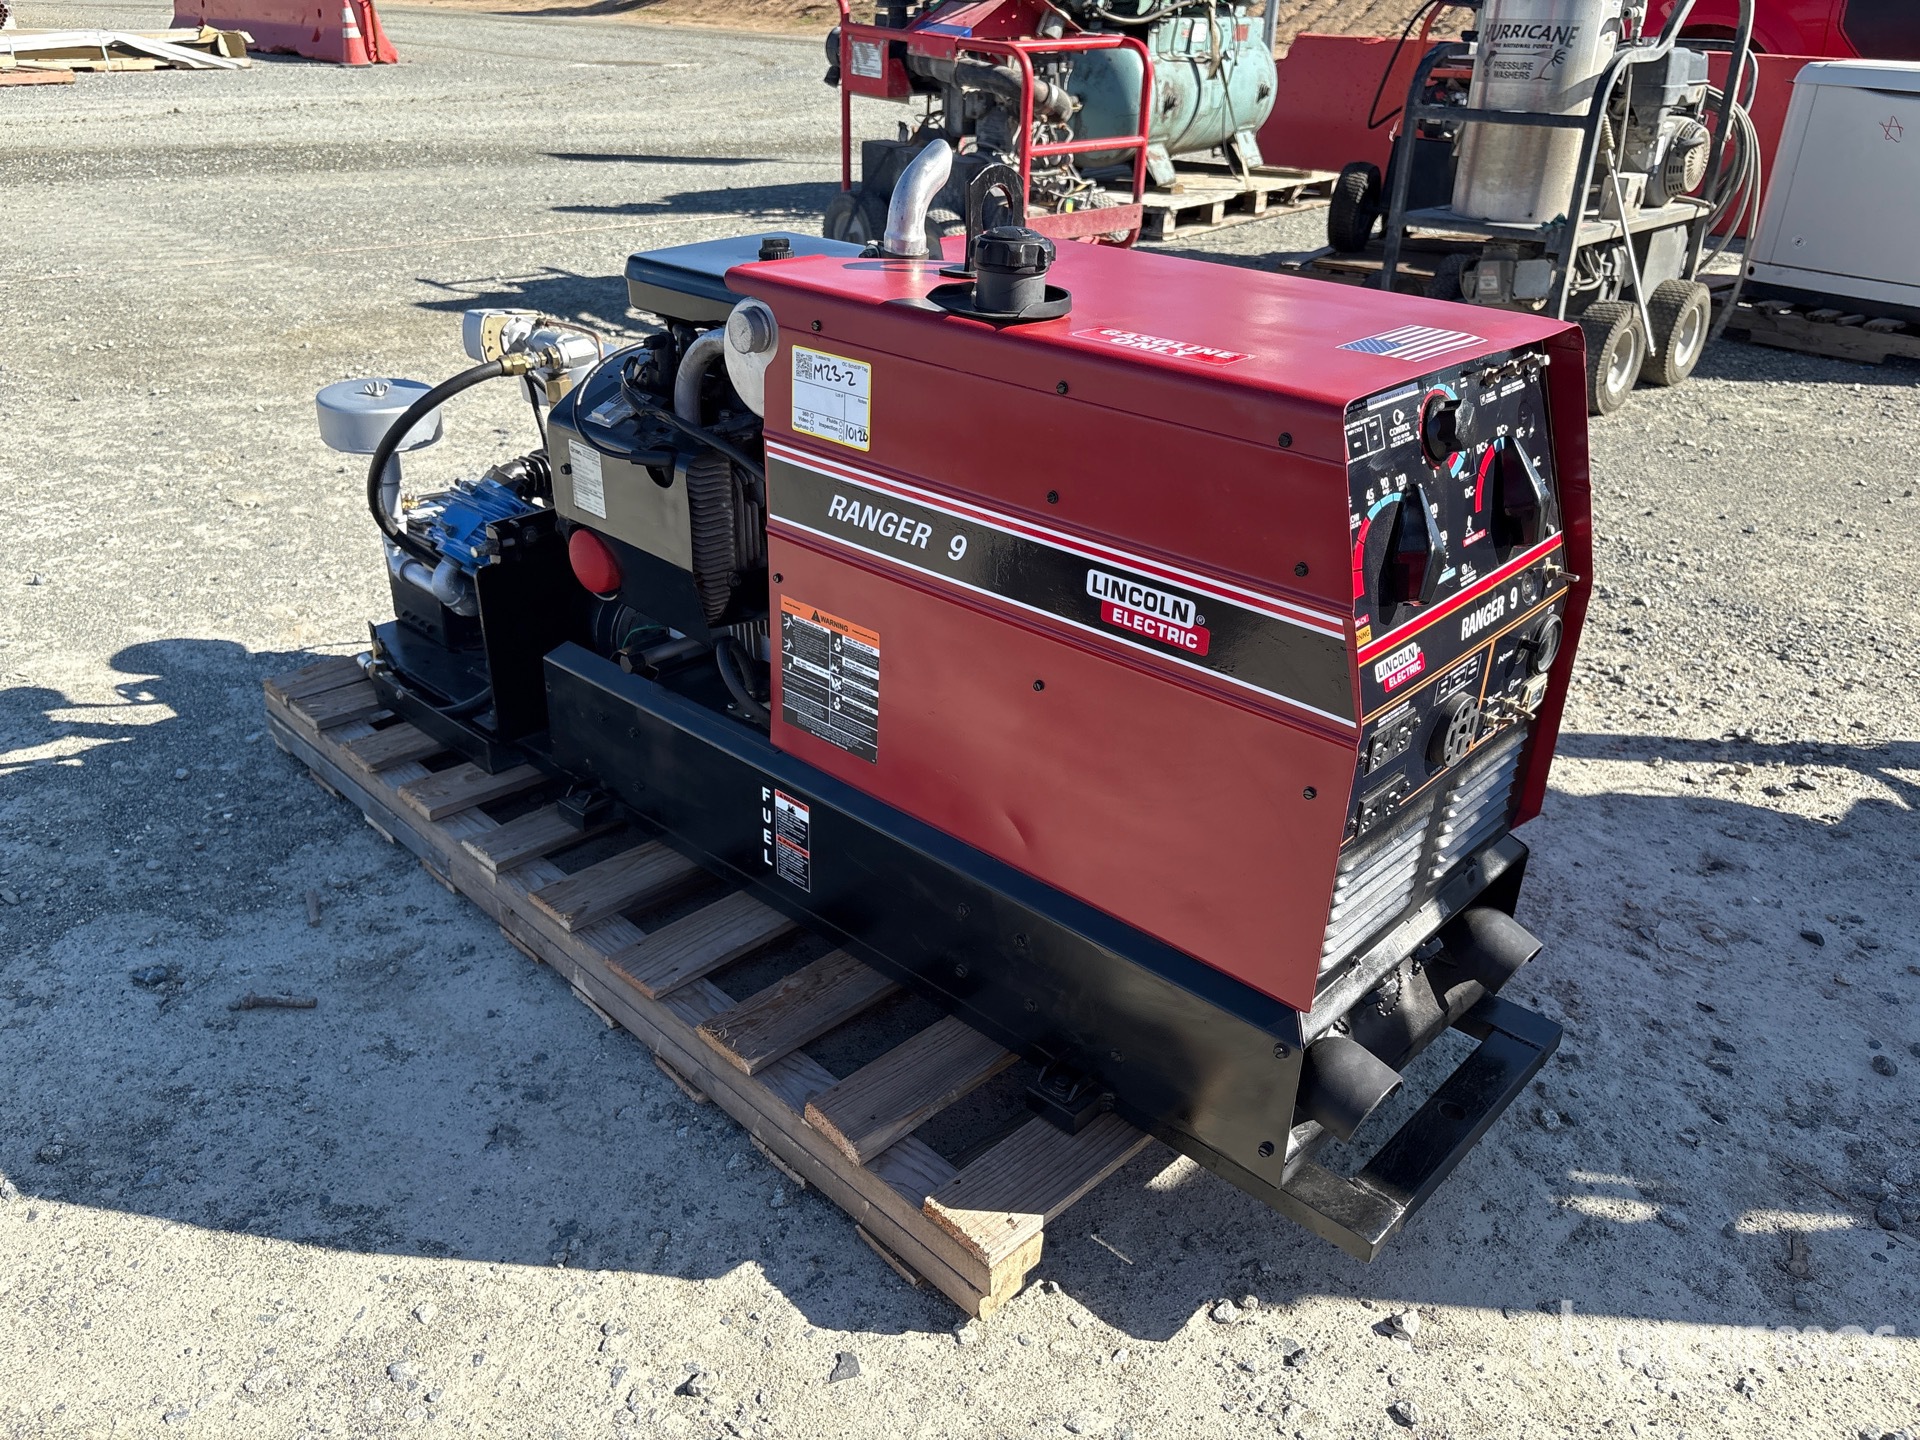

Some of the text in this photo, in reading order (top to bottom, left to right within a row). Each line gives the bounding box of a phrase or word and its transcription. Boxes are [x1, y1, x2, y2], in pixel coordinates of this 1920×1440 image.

[1484, 23, 1580, 48] HURRICANE
[1494, 61, 1534, 71] PRESSURE
[1494, 70, 1531, 80] WASHERS
[1100, 329, 1241, 359] GASOLINE
[1110, 337, 1198, 358] ONLY
[819, 421, 839, 432] Inspection
[1389, 422, 1411, 437] CONTROL
[1380, 477, 1389, 489] 90
[1395, 473, 1407, 487] 120
[1365, 488, 1375, 501] 45
[828, 494, 968, 561] RANGER 9
[1091, 573, 1190, 624] LINCOLN
[820, 615, 849, 632] WARNING
[1461, 586, 1518, 641] RANGER 9
[1112, 607, 1199, 649] ELECTRIC
[1379, 645, 1416, 680] LINCOLN
[1388, 660, 1422, 689] ELECTRIC
[762, 786, 773, 867] FUEL
